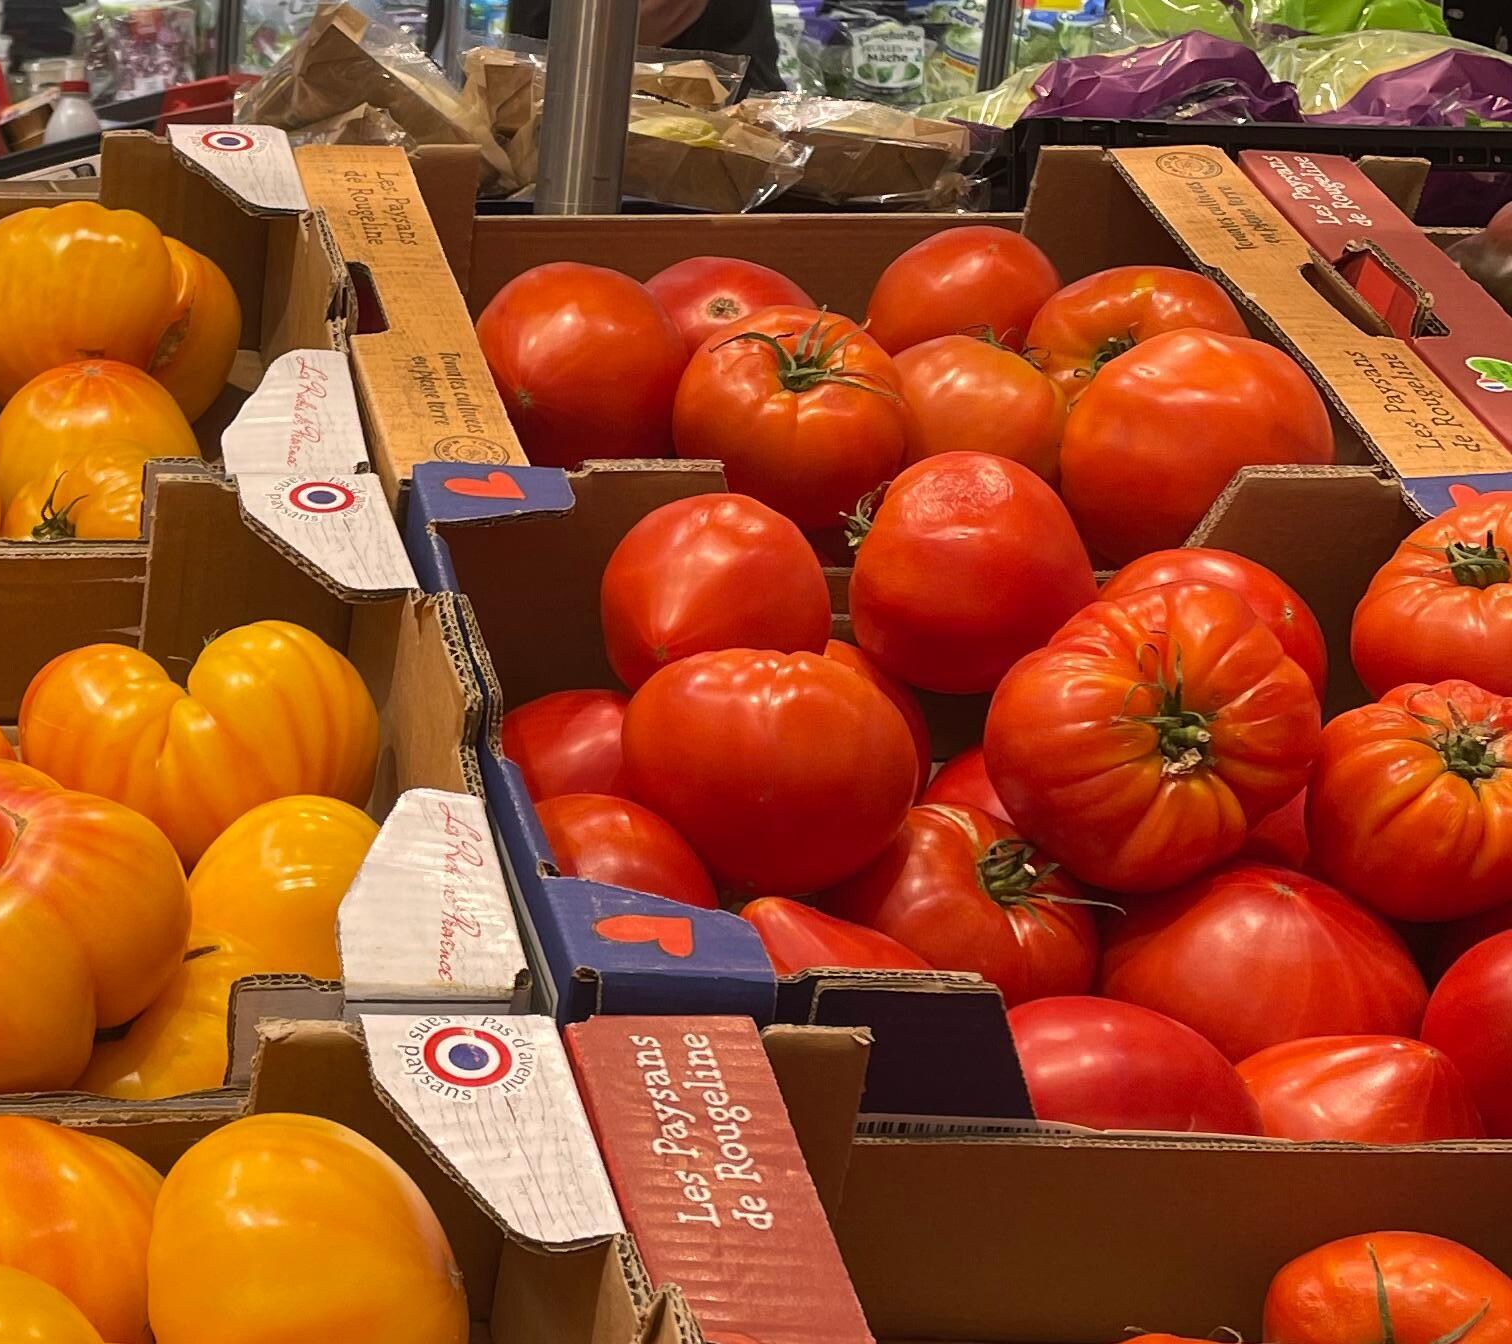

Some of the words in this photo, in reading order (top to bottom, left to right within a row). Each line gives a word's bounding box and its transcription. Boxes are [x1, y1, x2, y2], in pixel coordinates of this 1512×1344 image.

[344, 170, 367, 184] de
[376, 171, 399, 192] Les
[1261, 155, 1321, 201] Paysans
[1293, 156, 1361, 210] Rougeline
[348, 187, 387, 245] Rougeline
[383, 197, 418, 246] Paysans
[1307, 203, 1343, 226] Les
[1346, 212, 1373, 227] de
[438, 351, 468, 390] Tomates
[1343, 350, 1417, 414] Paysans
[1380, 351, 1464, 428] Rougeline
[426, 401, 450, 426] terre
[450, 392, 485, 434] cultivées
[1404, 420, 1446, 451] Les
[1451, 434, 1481, 453] de
[265, 493, 319, 522] paysans
[437, 909, 482, 982] Provence
[408, 1014, 452, 1044] sans
[480, 1016, 515, 1038] Pas
[397, 1043, 473, 1103] paysans
[502, 1028, 537, 1096] d'avenir
[629, 1035, 699, 1159] Paysans
[682, 1032, 763, 1184] Rougeline
[677, 1169, 721, 1228] Les
[731, 1194, 774, 1231] de
